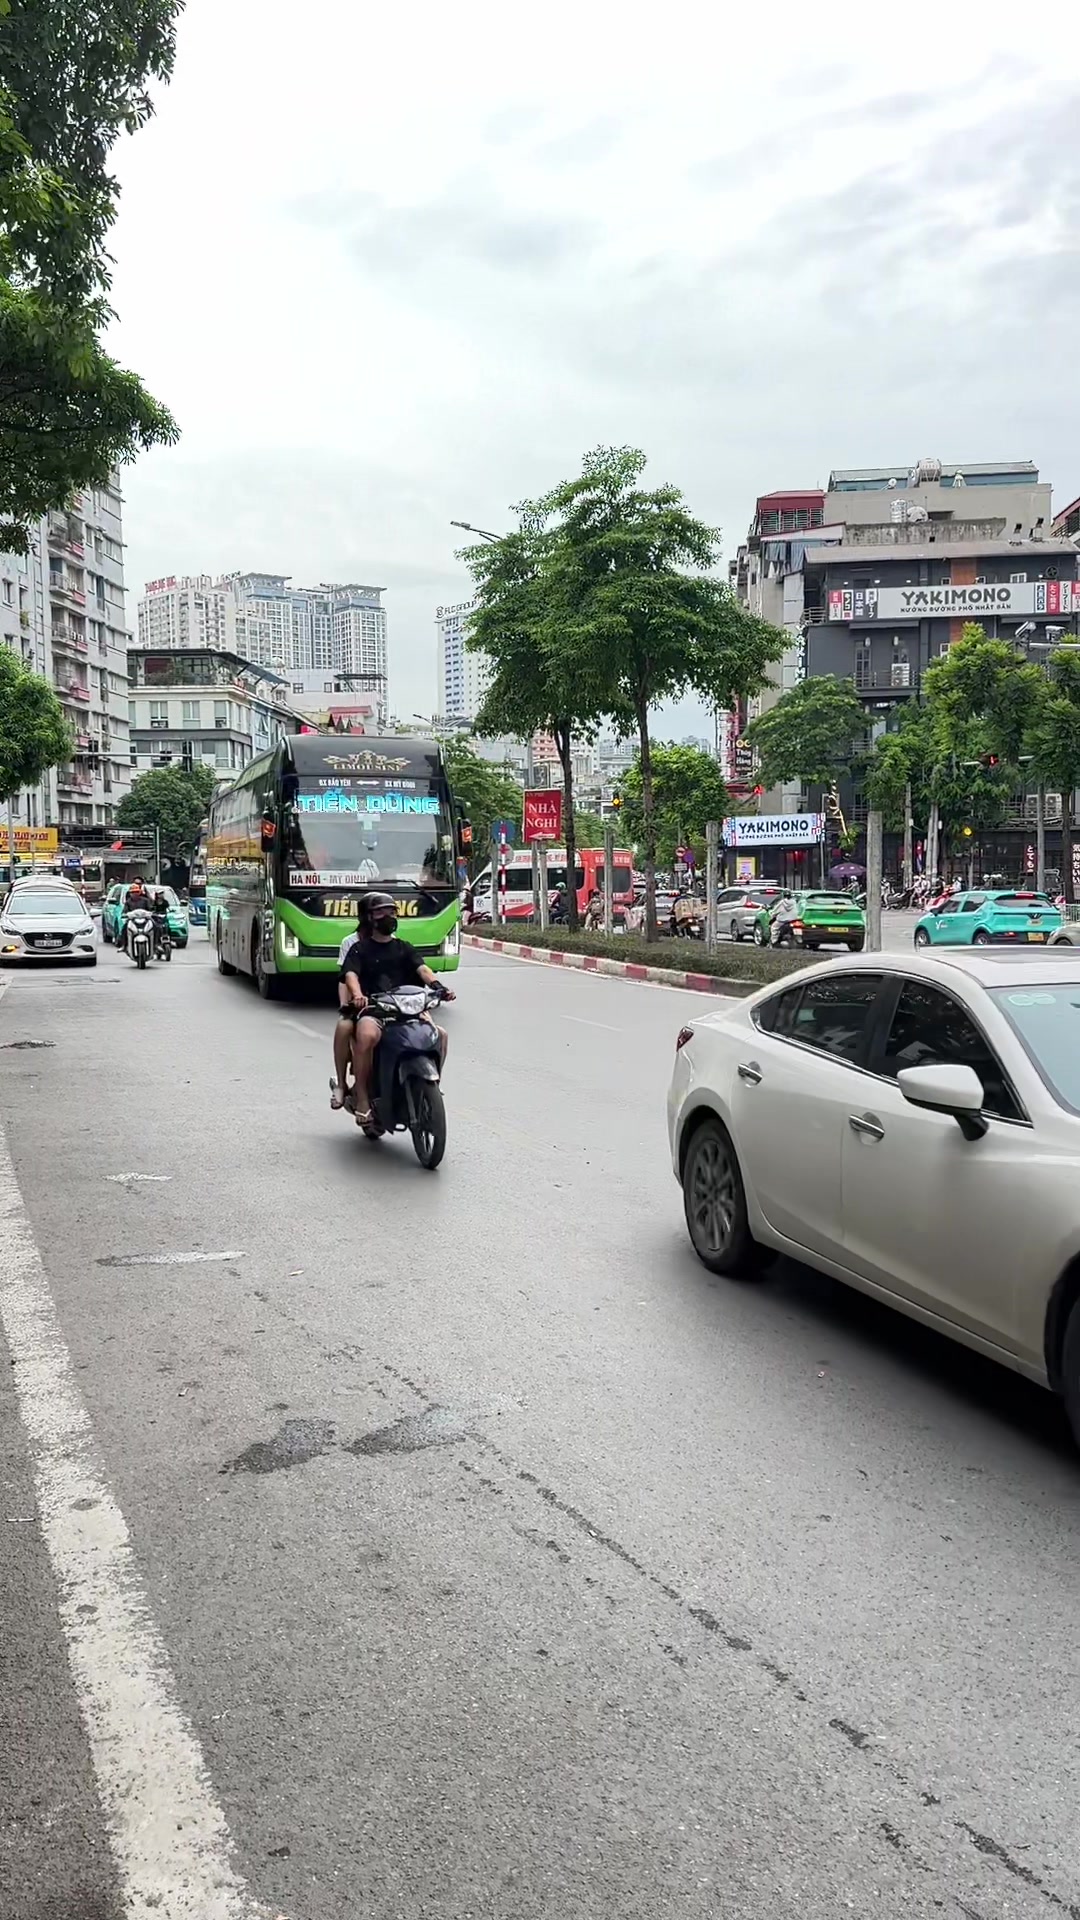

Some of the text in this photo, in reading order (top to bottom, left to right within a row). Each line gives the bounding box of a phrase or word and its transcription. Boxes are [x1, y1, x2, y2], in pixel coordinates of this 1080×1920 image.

[901, 587, 1012, 606] YAKIMONO
[297, 788, 440, 814] TIẾN DŨNG
[528, 800, 557, 814] NHÀ
[738, 819, 809, 834] YAKIMONO
[305, 872, 321, 884] NỘI
